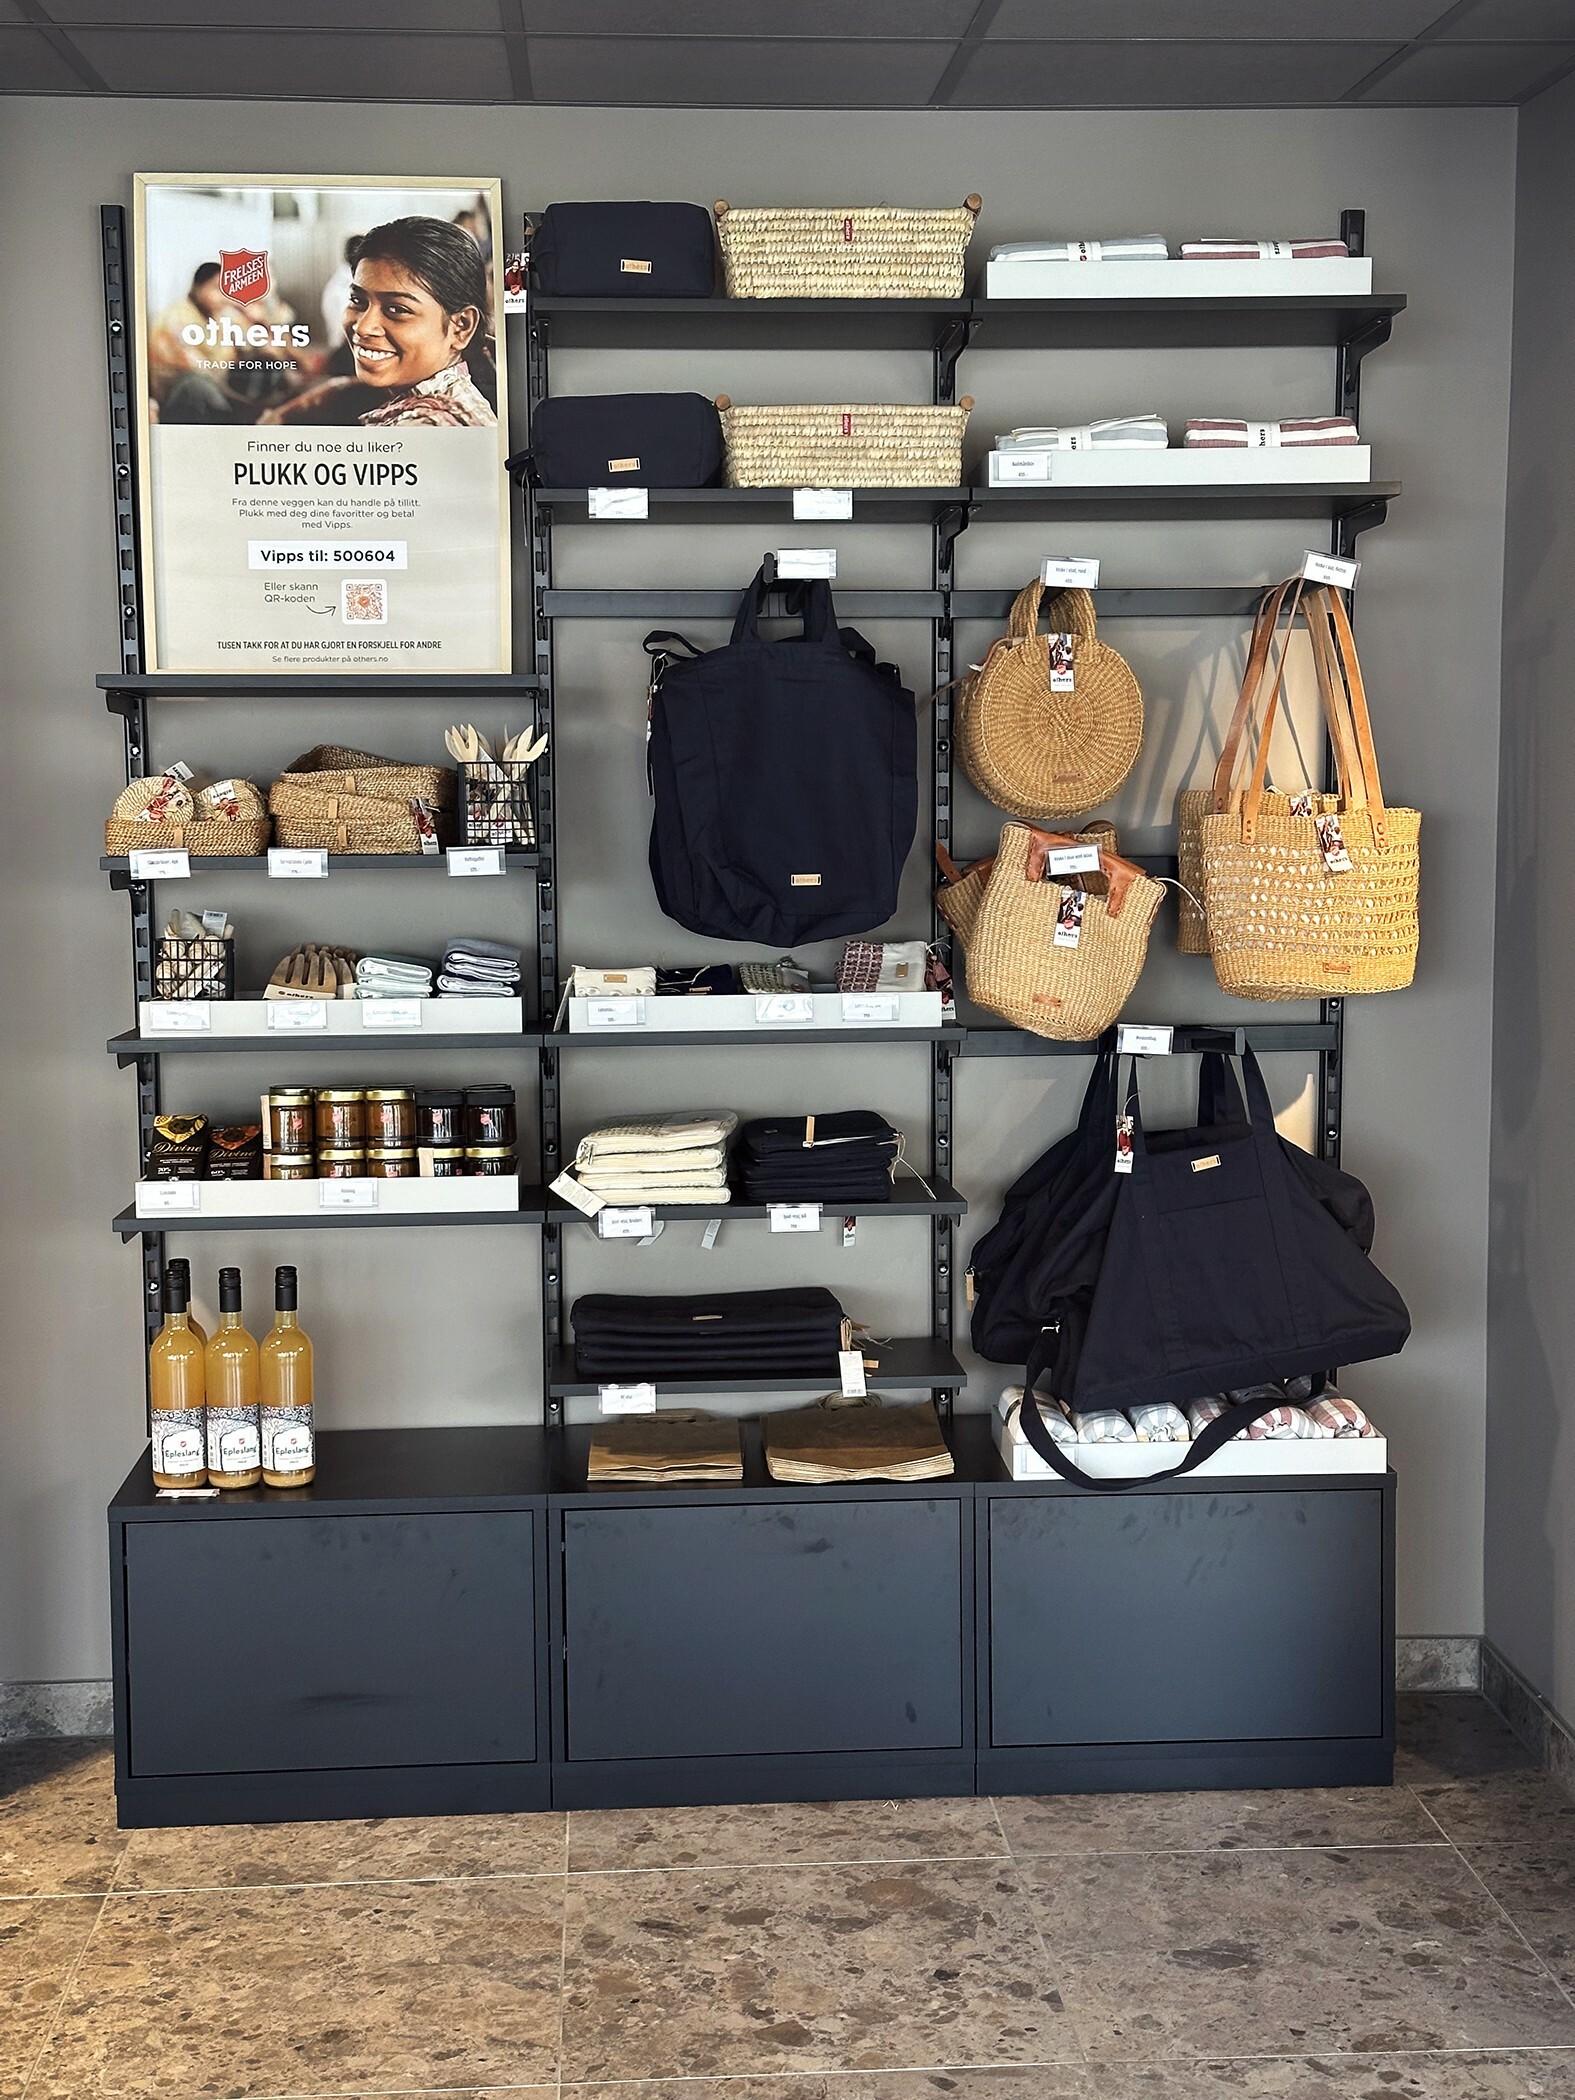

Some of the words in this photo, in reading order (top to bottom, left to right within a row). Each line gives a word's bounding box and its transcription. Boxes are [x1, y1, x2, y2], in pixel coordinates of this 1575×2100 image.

[228, 268, 264, 295] ARMEEN
[181, 316, 310, 347] others
[197, 360, 235, 370] TRADE
[239, 360, 262, 370] FOR
[266, 360, 297, 370] HOPE
[247, 441, 290, 452] Finner
[295, 441, 312, 452] du
[317, 444, 342, 453] noe
[346, 441, 363, 453] du
[368, 441, 403, 453] liker?
[234, 463, 308, 485] PLUKK
[314, 463, 347, 485] OG
[353, 463, 418, 485] VIPPS
[232, 498, 249, 506] Fra
[250, 498, 279, 506] denne
[280, 500, 315, 508] veggen
[317, 498, 334, 506] kan
[336, 498, 348, 506] du
[350, 498, 381, 506] handle
[384, 498, 396, 509] på
[398, 498, 421, 506] tillitt.
[239, 509, 264, 518] Plukk
[266, 509, 288, 518] med
[289, 510, 307, 519] deg
[310, 509, 330, 518] dine
[332, 509, 374, 518] favoritter
[391, 509, 415, 518] betal
[302, 521, 323, 529] med
[325, 521, 352, 529] Vipps.
[261, 550, 304, 564] Vipps
[309, 550, 328, 562] til:
[334, 550, 395, 562] 500604
[264, 582, 286, 591] Eller
[290, 582, 319, 591] skann
[264, 594, 316, 603] QR-koden
[217, 641, 242, 650] TUSEN
[243, 641, 263, 650] TAKK
[264, 641, 280, 650] FOR
[280, 641, 290, 650] AT
[291, 641, 302, 650] DU
[303, 641, 320, 650] HAR
[321, 641, 346, 650] GJORT
[347, 641, 357, 650] EN
[358, 641, 398, 650] FORSKJELL
[400, 641, 415, 650] FOR
[416, 641, 442, 650] ANDRE
[303, 656, 340, 664] produkter
[341, 656, 351, 664] på
[152, 1142, 203, 1154] Divine
[207, 1149, 256, 1160] Divine
